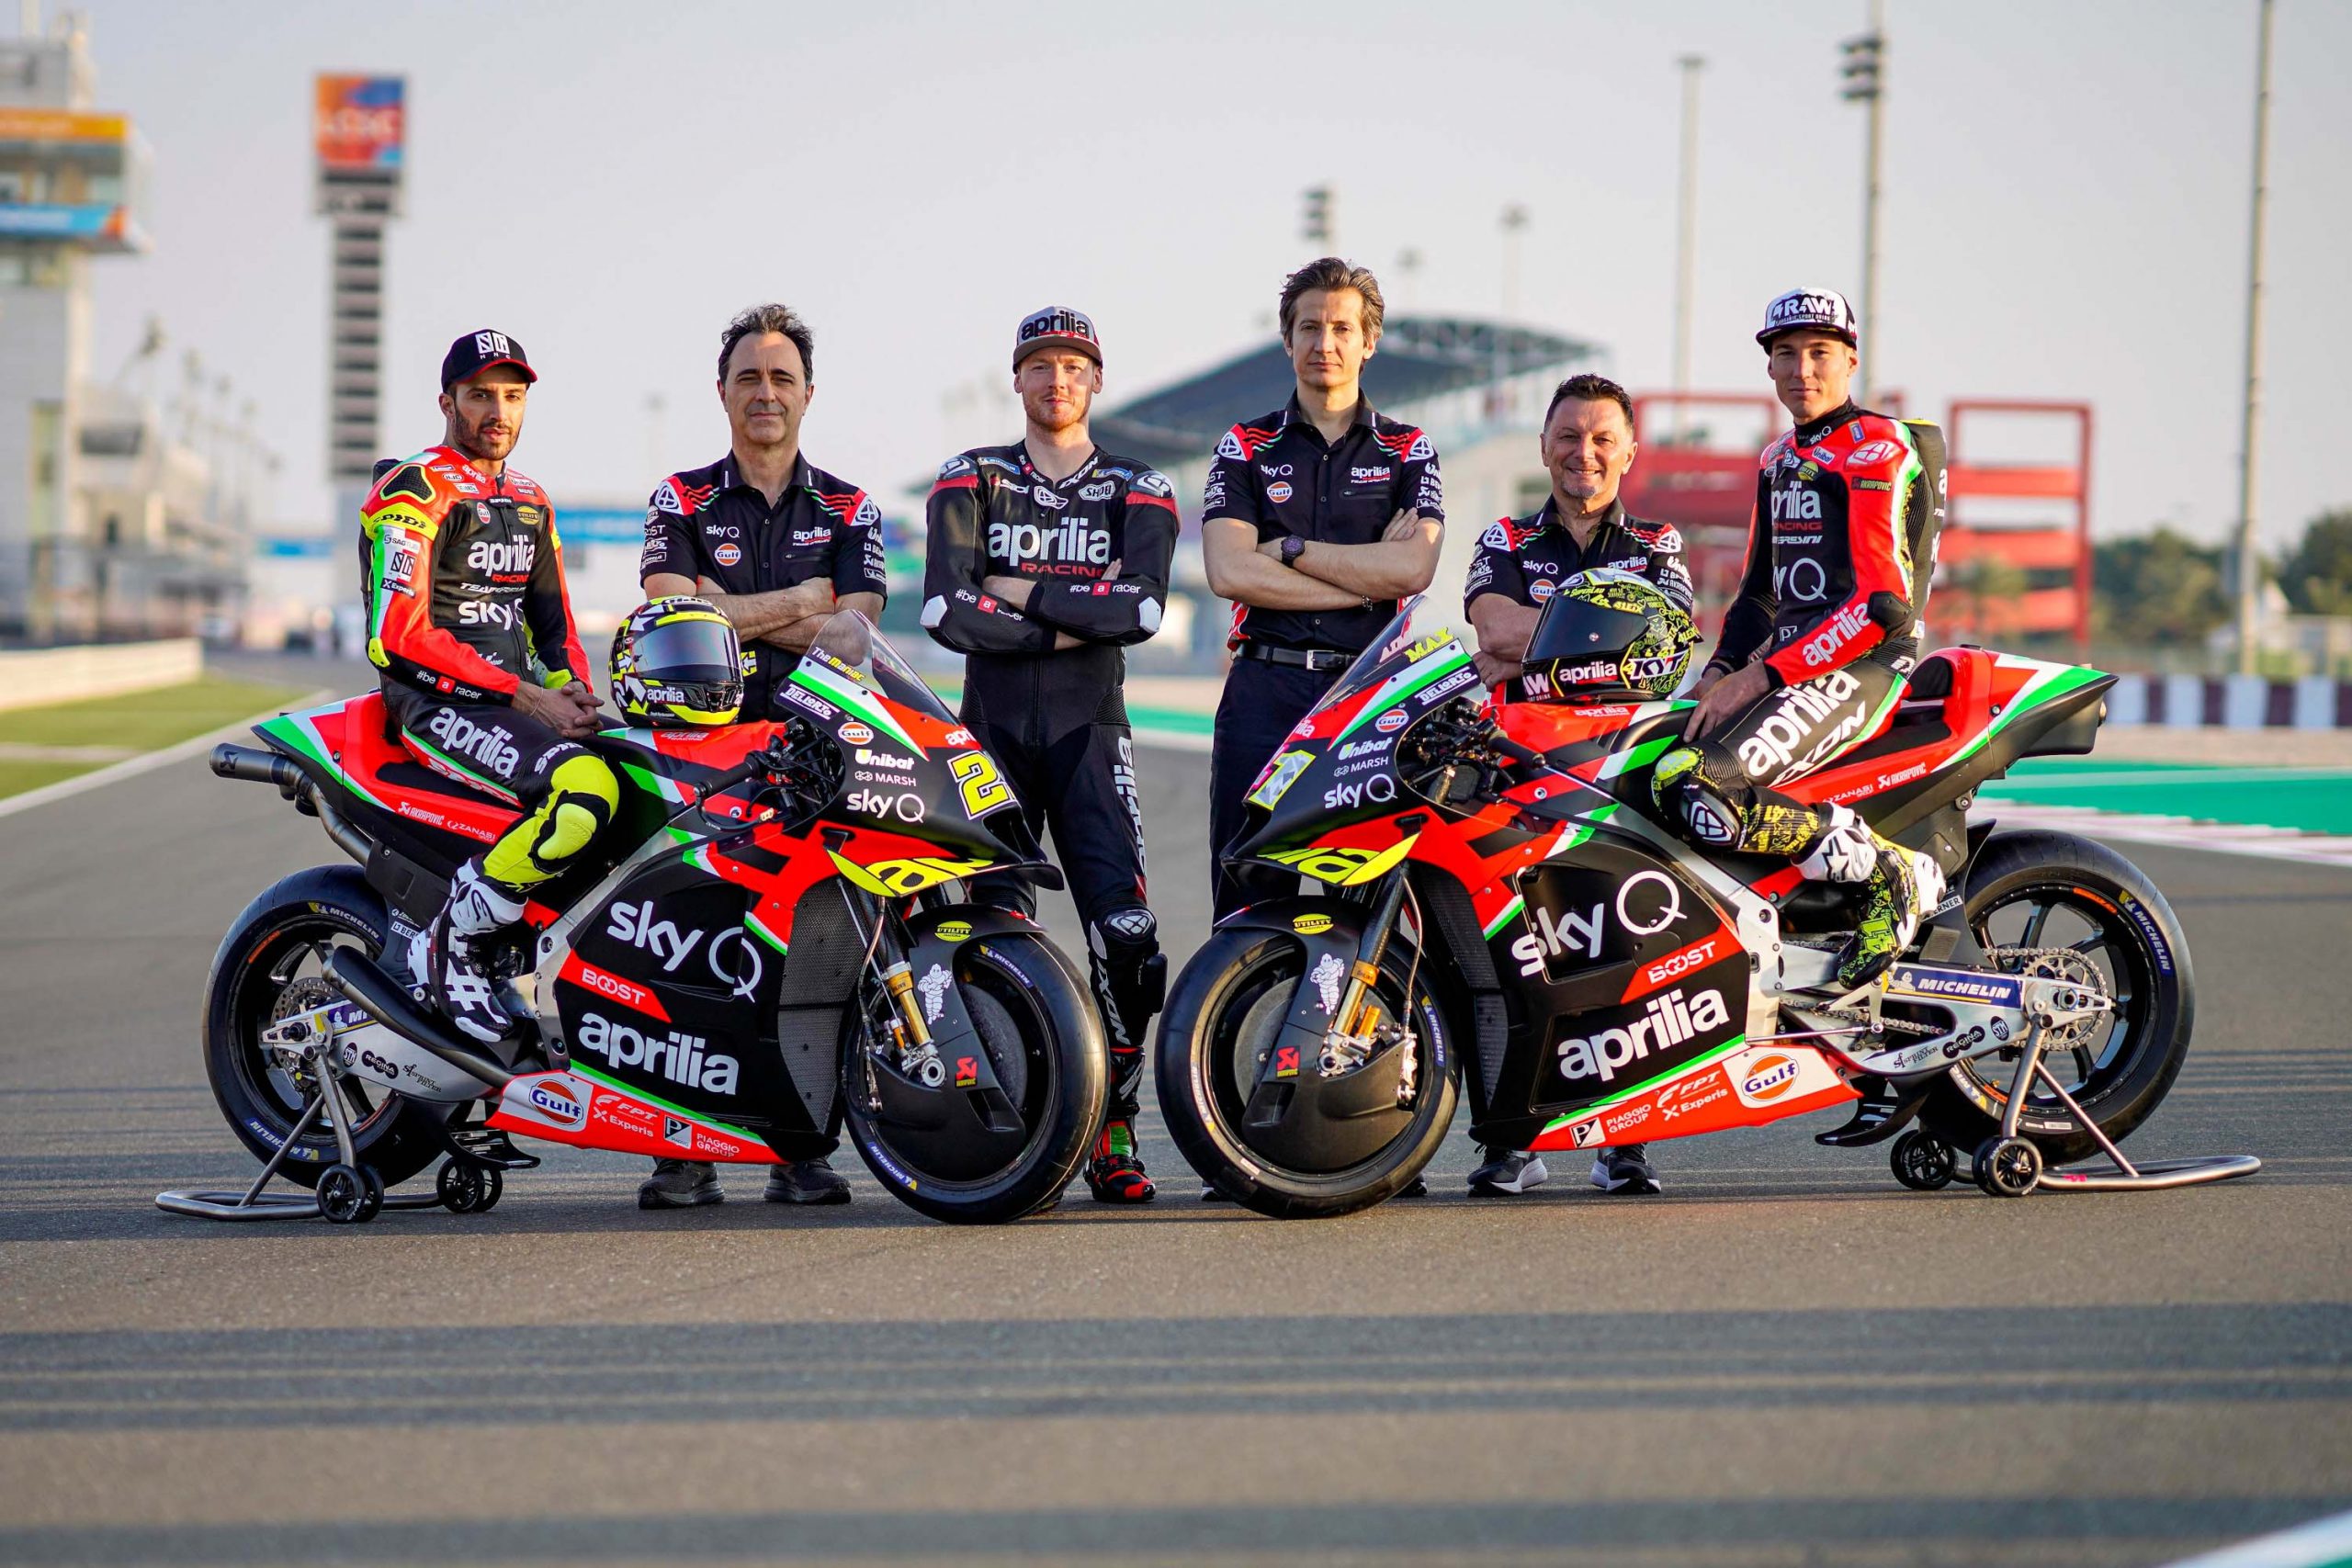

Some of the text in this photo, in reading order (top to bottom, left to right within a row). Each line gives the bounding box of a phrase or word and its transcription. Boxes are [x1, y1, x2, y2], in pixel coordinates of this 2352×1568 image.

[1022, 310, 1090, 340] aprilia
[1814, 447, 1833, 463] Unibat
[1059, 457, 1099, 490] IXON
[1351, 467, 1390, 479] aprilia
[1771, 480, 1822, 526] prilia
[706, 525, 740, 538] sky Q
[793, 526, 831, 542] aprilia
[989, 516, 1111, 566] aprilia
[468, 535, 535, 577] aprilia
[717, 551, 739, 559] Gulf
[1608, 557, 1647, 570] aprilia
[1522, 560, 1558, 575] sky Q
[1790, 558, 1827, 601] Q
[956, 589, 977, 604] #be
[1069, 584, 1091, 592] #be
[1112, 584, 1142, 593] racer
[1532, 586, 1555, 595] Gulf
[458, 600, 513, 631] sky
[1404, 626, 1454, 663] MAX
[1803, 603, 1871, 666] aprilia
[1559, 660, 1617, 683] aprilia
[1630, 651, 1688, 680] KYT
[416, 670, 436, 684] #be
[454, 684, 482, 700] racer
[647, 686, 685, 703] aprilia
[1379, 715, 1407, 726] Gulf
[1574, 706, 1628, 716] aprilia
[841, 728, 871, 739] Gulf
[1738, 670, 1861, 777] aprilia
[429, 706, 520, 779] aprilia
[1338, 737, 1393, 761] Unibat
[1768, 701, 1866, 788] IXON
[855, 749, 914, 771] Unibat
[1351, 756, 1388, 773] MARSH
[876, 773, 916, 787] MARSH
[1324, 773, 1398, 808] sky Q
[847, 788, 924, 823] sky Q
[1934, 897, 1961, 915] ERNER
[330, 908, 379, 939] MICHELIN
[1294, 919, 1332, 928] UTILITY
[1512, 870, 1688, 977] sky Q
[606, 901, 762, 1003] sky Q
[2134, 910, 2171, 970] MICHELIN
[994, 953, 1031, 985] MICHELIN
[1647, 941, 1716, 985] BOOST
[582, 968, 646, 1005] BOOST
[1918, 978, 2012, 998] MICHELIN
[1429, 1014, 1445, 1062] MICHELIN
[1557, 988, 1730, 1082] aprilia
[1992, 1021, 2008, 1036] STM
[578, 1012, 740, 1095] aprilia
[1947, 1031, 1983, 1054] REGINA
[344, 1048, 357, 1063] STM
[366, 1054, 395, 1073] REGINA
[1680, 1070, 1721, 1095] FPT
[1745, 1062, 1797, 1094] Gulf
[531, 1089, 582, 1118] Gulf
[617, 1103, 658, 1120] FPT
[1680, 1089, 1728, 1112] Experis
[609, 1114, 654, 1138] Experis
[666, 1117, 683, 1135] P
[1606, 1103, 1652, 1127] PIAGGIO
[1609, 1112, 1648, 1134] GROUP
[696, 1133, 740, 1154] PIAGGIO
[1573, 1123, 1590, 1145] P
[696, 1141, 734, 1157] GROUP
[871, 1145, 905, 1179] MICHELIN
